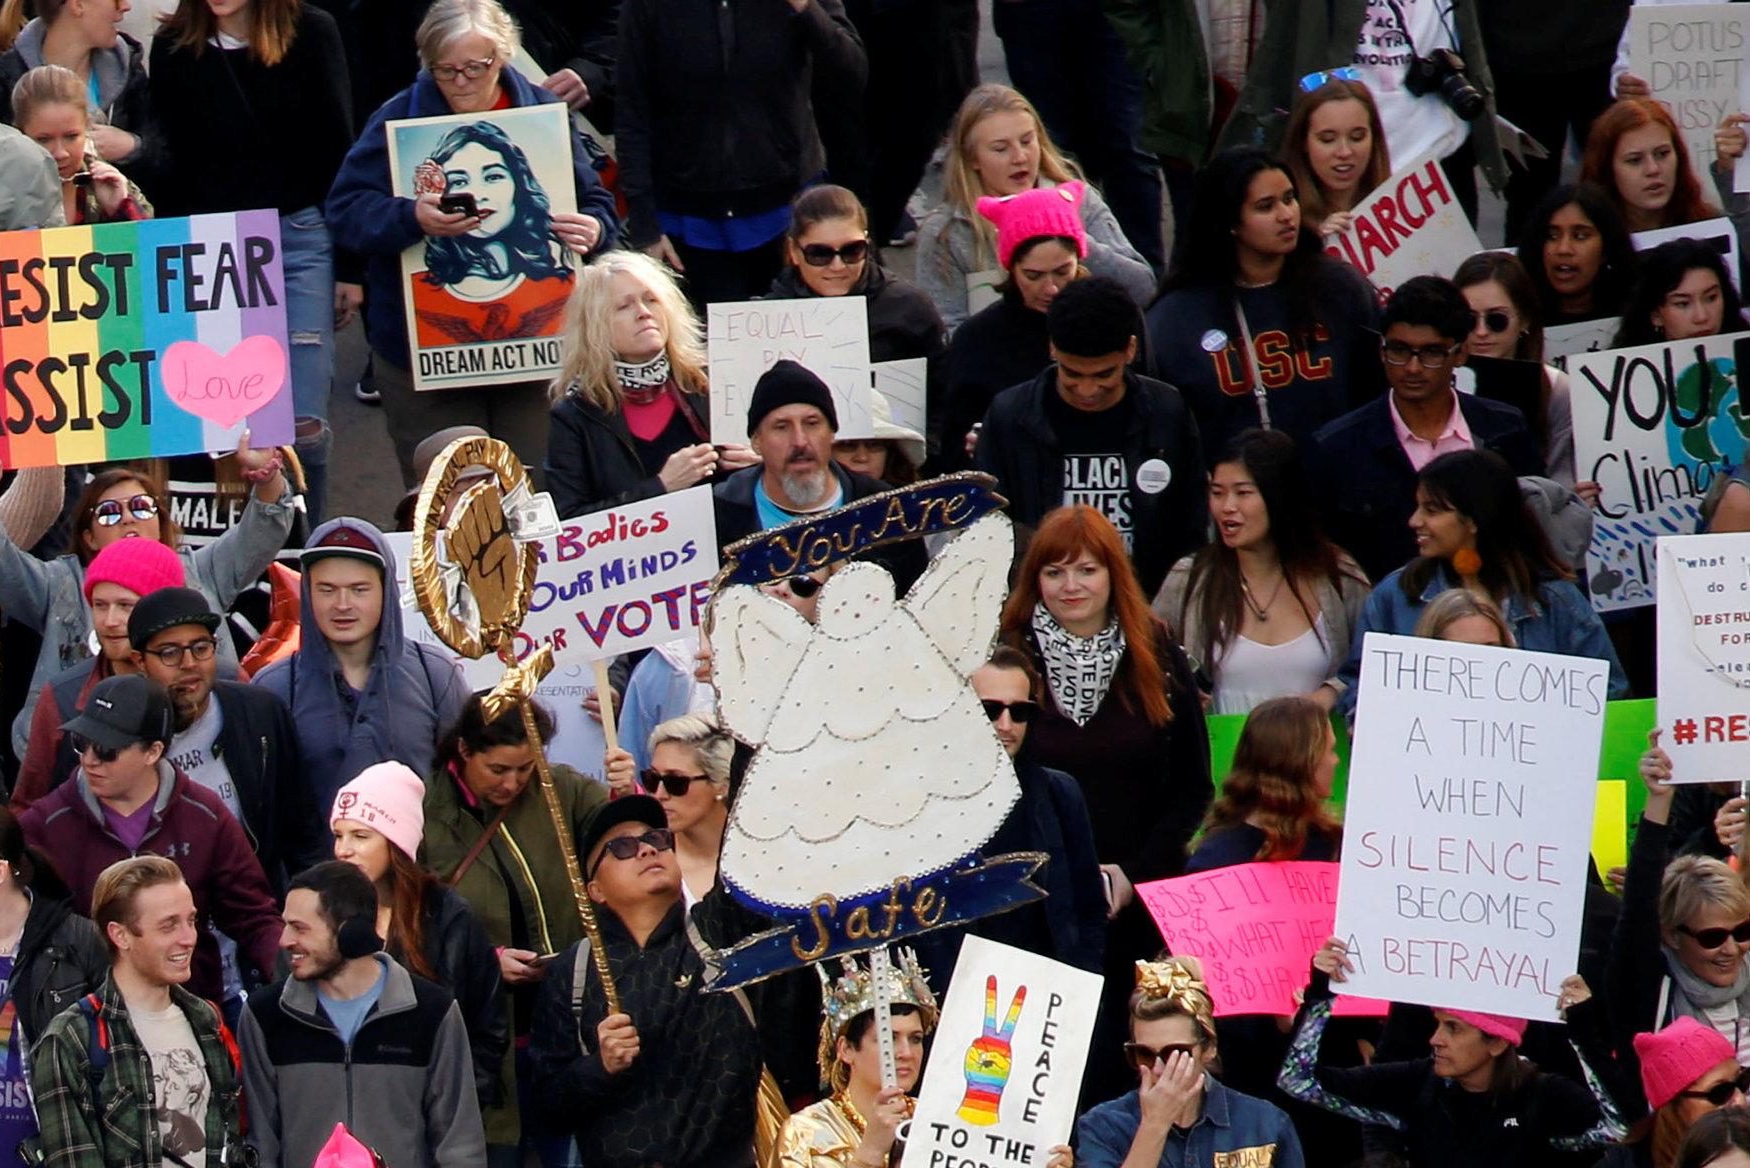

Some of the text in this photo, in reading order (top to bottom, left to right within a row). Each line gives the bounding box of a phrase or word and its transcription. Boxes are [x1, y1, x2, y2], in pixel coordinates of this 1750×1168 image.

[1649, 20, 1744, 55] POTUS
[1650, 58, 1744, 93] DRAFT
[155, 236, 278, 313] FEAR
[727, 310, 823, 343] EQUAL
[177, 356, 268, 402] Love
[419, 340, 564, 376] DREAM ACT NO
[1211, 323, 1333, 397] USC
[1580, 344, 1712, 441] YOU
[769, 494, 976, 578] You Are
[1707, 582, 1725, 593] do
[1694, 611, 1750, 626] DESTRU
[1371, 650, 1603, 716] THERE COMES
[1406, 717, 1538, 765] A TIME
[1673, 715, 1750, 746] #RE
[1414, 774, 1524, 818] WHEN
[1357, 831, 1561, 885] SILENCE
[792, 875, 947, 961] Safe
[1396, 884, 1556, 938] BECOMES
[1206, 920, 1285, 960] WHAT
[1345, 933, 1562, 997] A BETRAYAL
[1023, 993, 1062, 1124] PEACE
[929, 1123, 1036, 1165] TO THE
